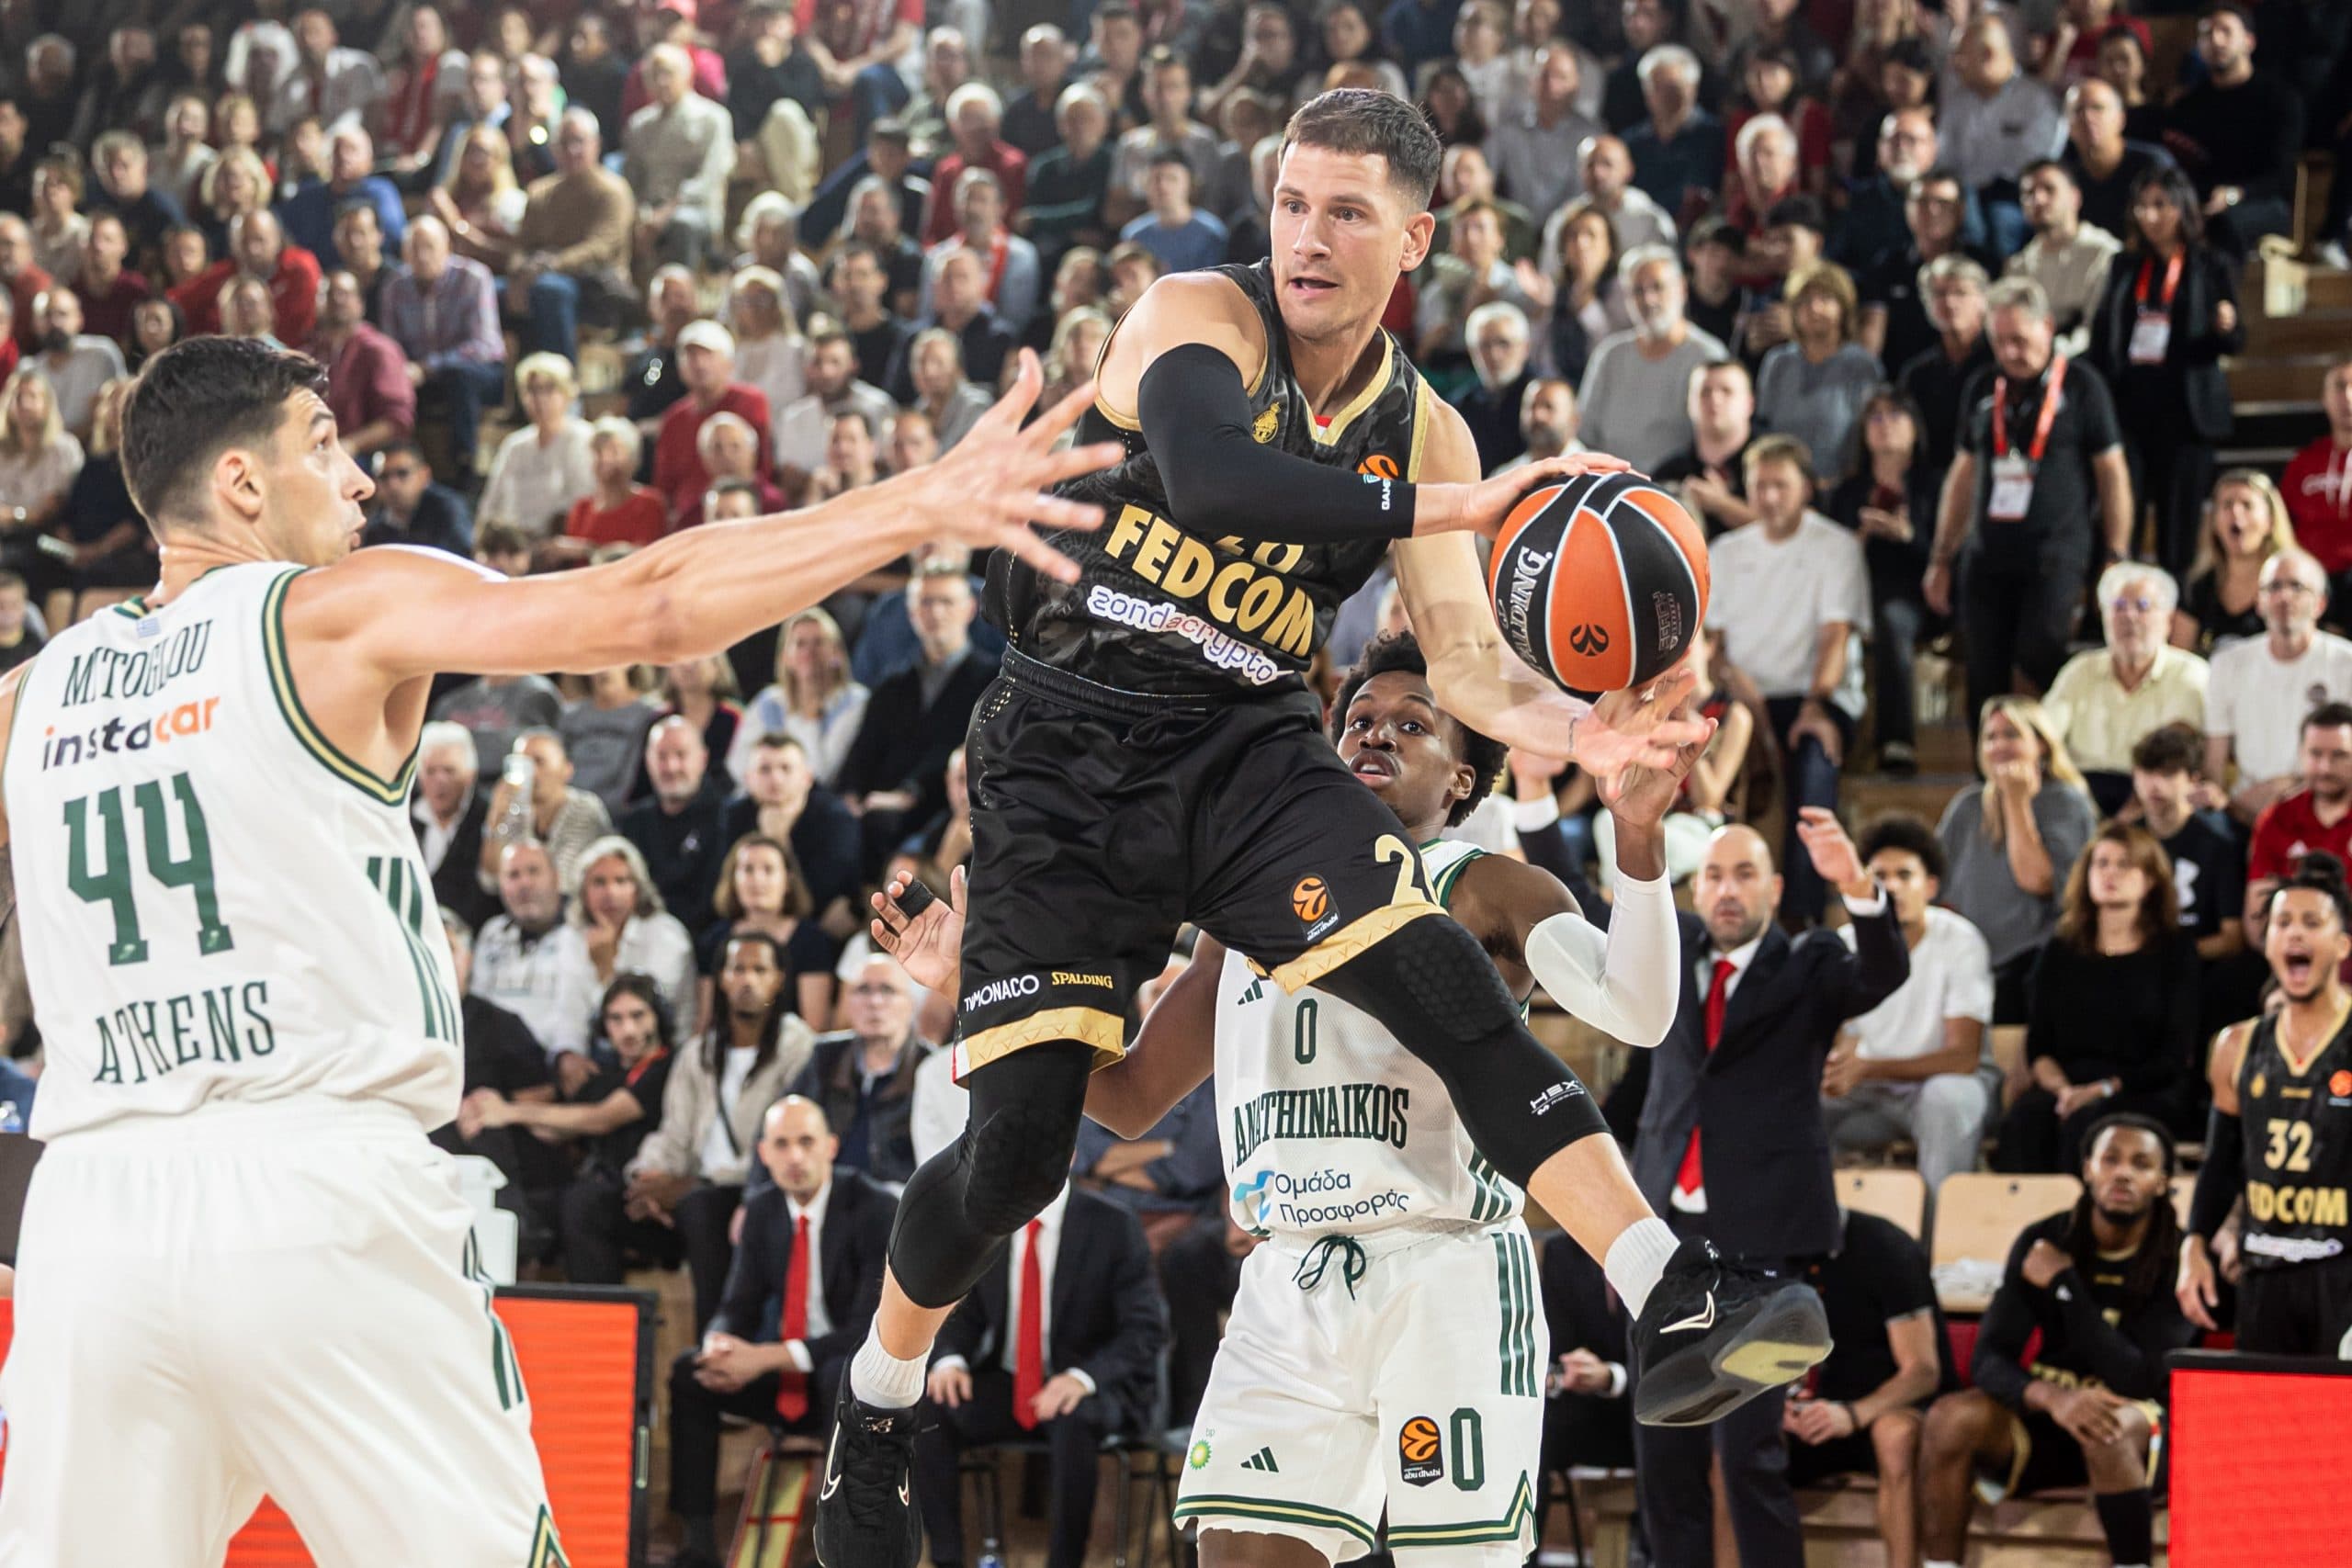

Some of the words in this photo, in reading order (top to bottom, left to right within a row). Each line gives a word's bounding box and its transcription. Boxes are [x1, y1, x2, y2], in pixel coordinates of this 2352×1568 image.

[1104, 503, 1315, 658] FEDCOM
[61, 619, 213, 707] MTOGLOU
[1088, 587, 1278, 683] zondacrypto
[42, 696, 220, 771] instacar
[62, 772, 234, 965] 44
[1051, 971, 1114, 989] SPALDING
[93, 981, 275, 1084] ATHENS
[1295, 998, 1318, 1065] 0
[1232, 1083, 1409, 1174] ANATHINAIKOS
[1530, 1080, 1578, 1109] HEX
[1275, 1169, 1351, 1200] Ομάδα
[2264, 1117, 2313, 1173] 32
[1280, 1189, 1409, 1228] Προσφοράς
[1450, 1407, 1485, 1491] 0
